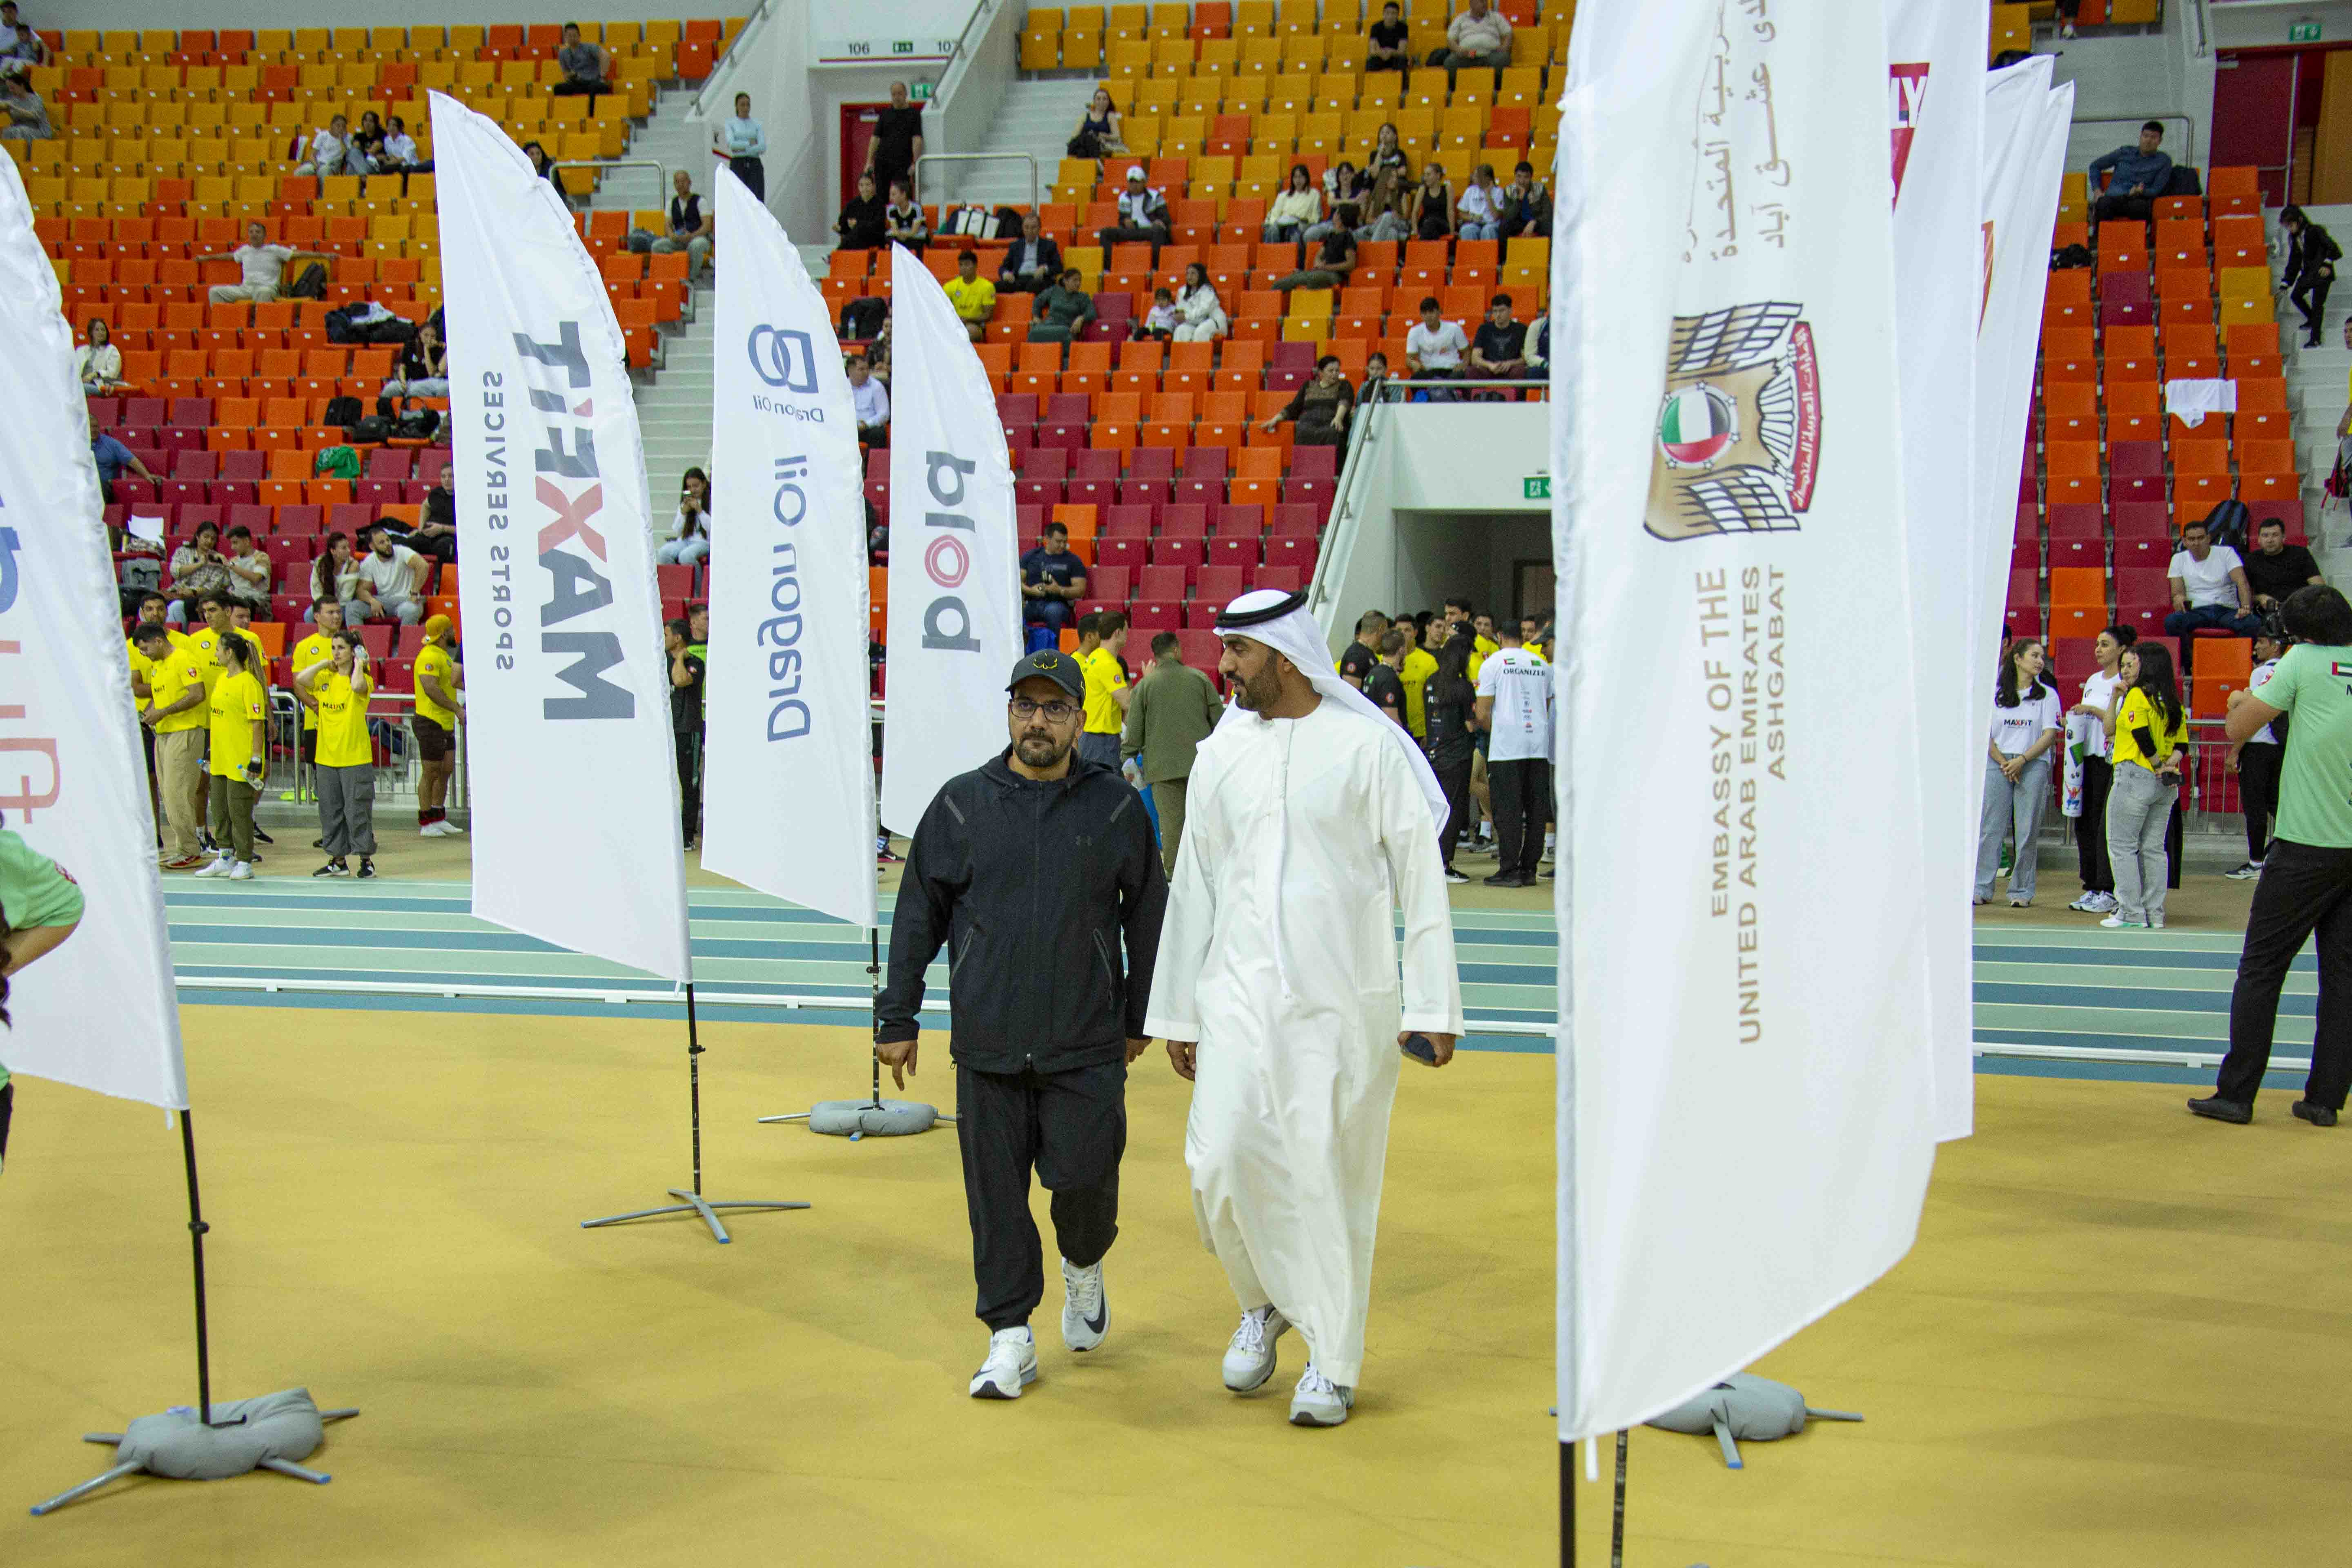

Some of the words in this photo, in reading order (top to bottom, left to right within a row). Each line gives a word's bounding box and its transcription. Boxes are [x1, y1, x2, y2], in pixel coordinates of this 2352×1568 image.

[848, 40, 870, 55] 106
[1889, 75, 1928, 129] LY
[1703, 141, 1737, 261] المتحدة
[1696, 568, 1731, 647] THE
[1503, 668, 1546, 676] ORGANIZER
[1704, 660, 1733, 712] OF
[1741, 566, 1760, 764] EMIRATES
[1768, 566, 1785, 780] ASHGABAT
[1707, 726, 1733, 918] EMBASSY
[1738, 778, 1757, 888] ARAB
[1738, 902, 1762, 1044] UNITED
